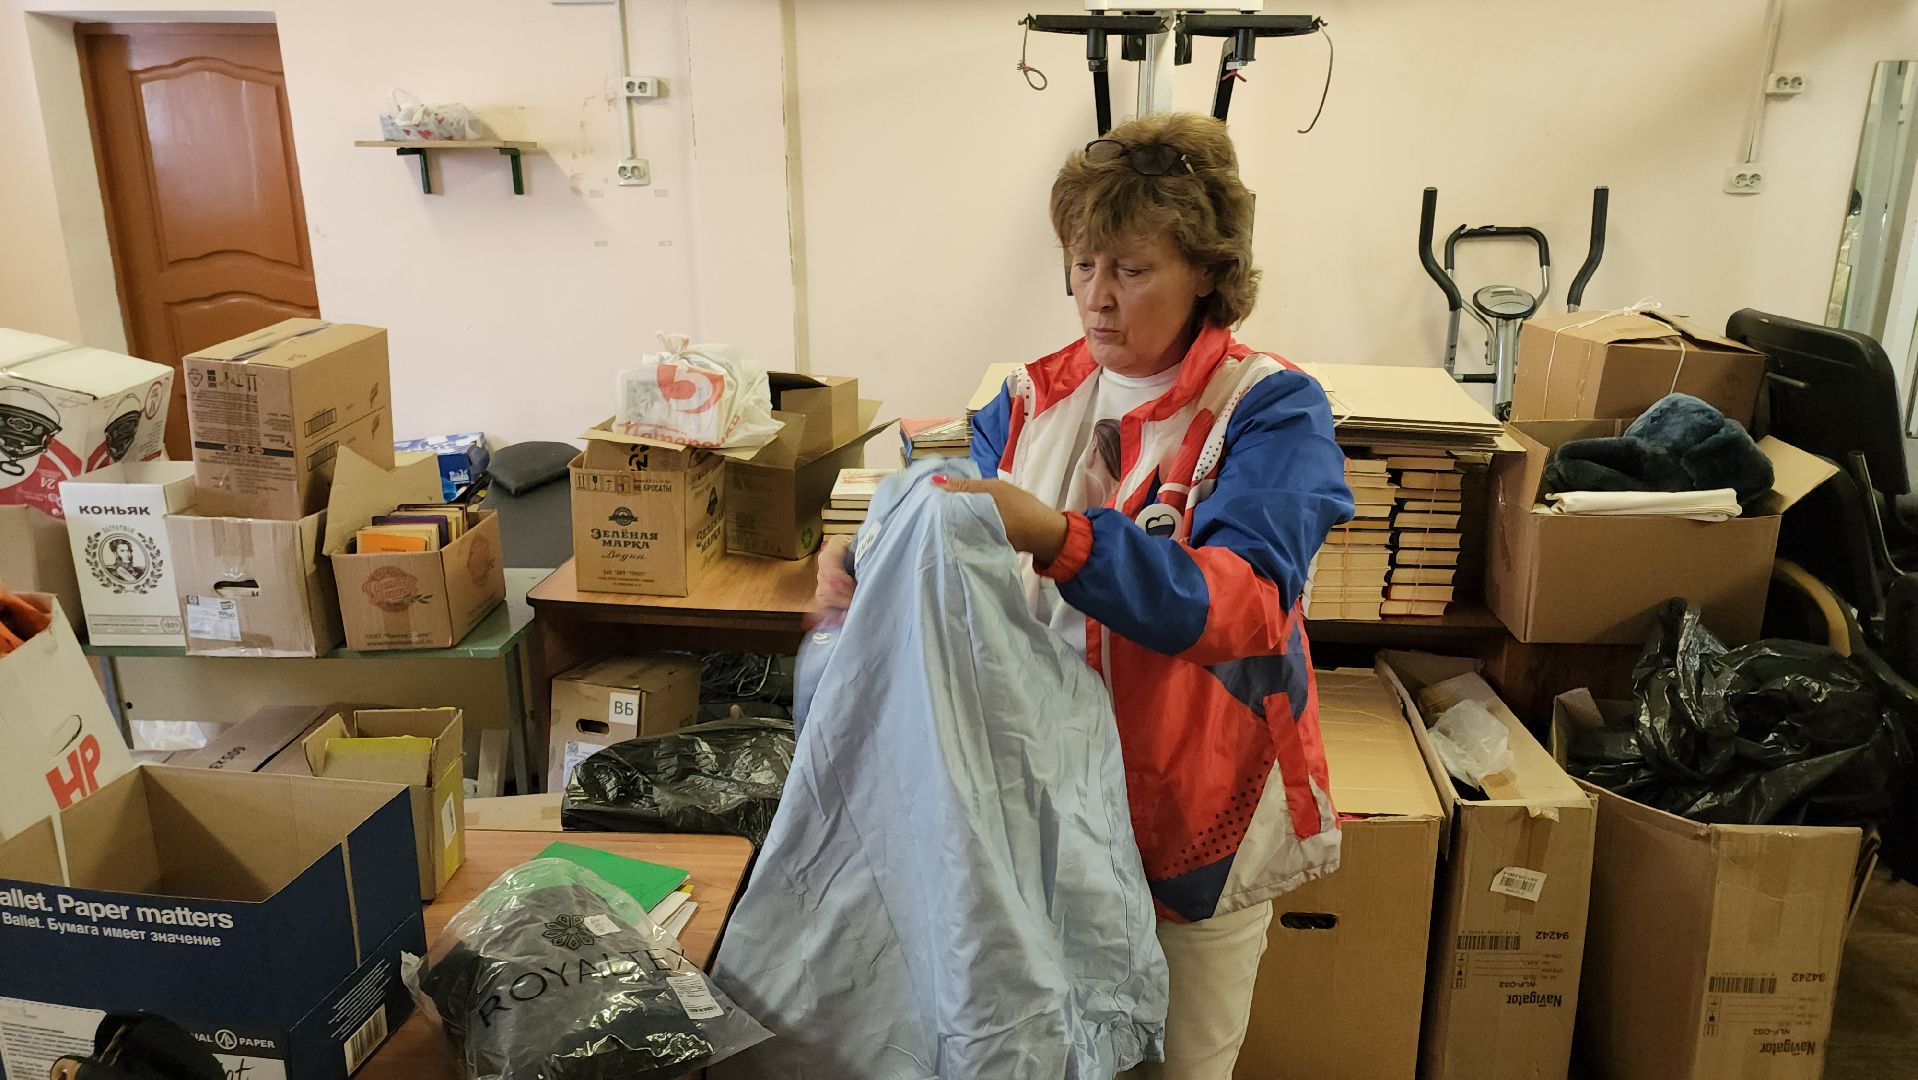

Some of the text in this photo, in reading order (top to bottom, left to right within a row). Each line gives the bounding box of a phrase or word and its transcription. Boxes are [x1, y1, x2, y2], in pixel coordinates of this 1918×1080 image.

[79, 505, 151, 516] КОНЬЯК
[601, 539, 650, 550] МАРКА
[613, 700, 634, 716] ВБ
[0, 888, 234, 929] allet. Paper matters
[1, 911, 222, 947] Ballet. Бумага имеет значение
[1535, 931, 1569, 940] 94242
[1791, 972, 1826, 982] 94242
[1506, 991, 1562, 1008] Navigator
[239, 1037, 276, 1049] PAPER
[1760, 1039, 1816, 1056] Navigator
